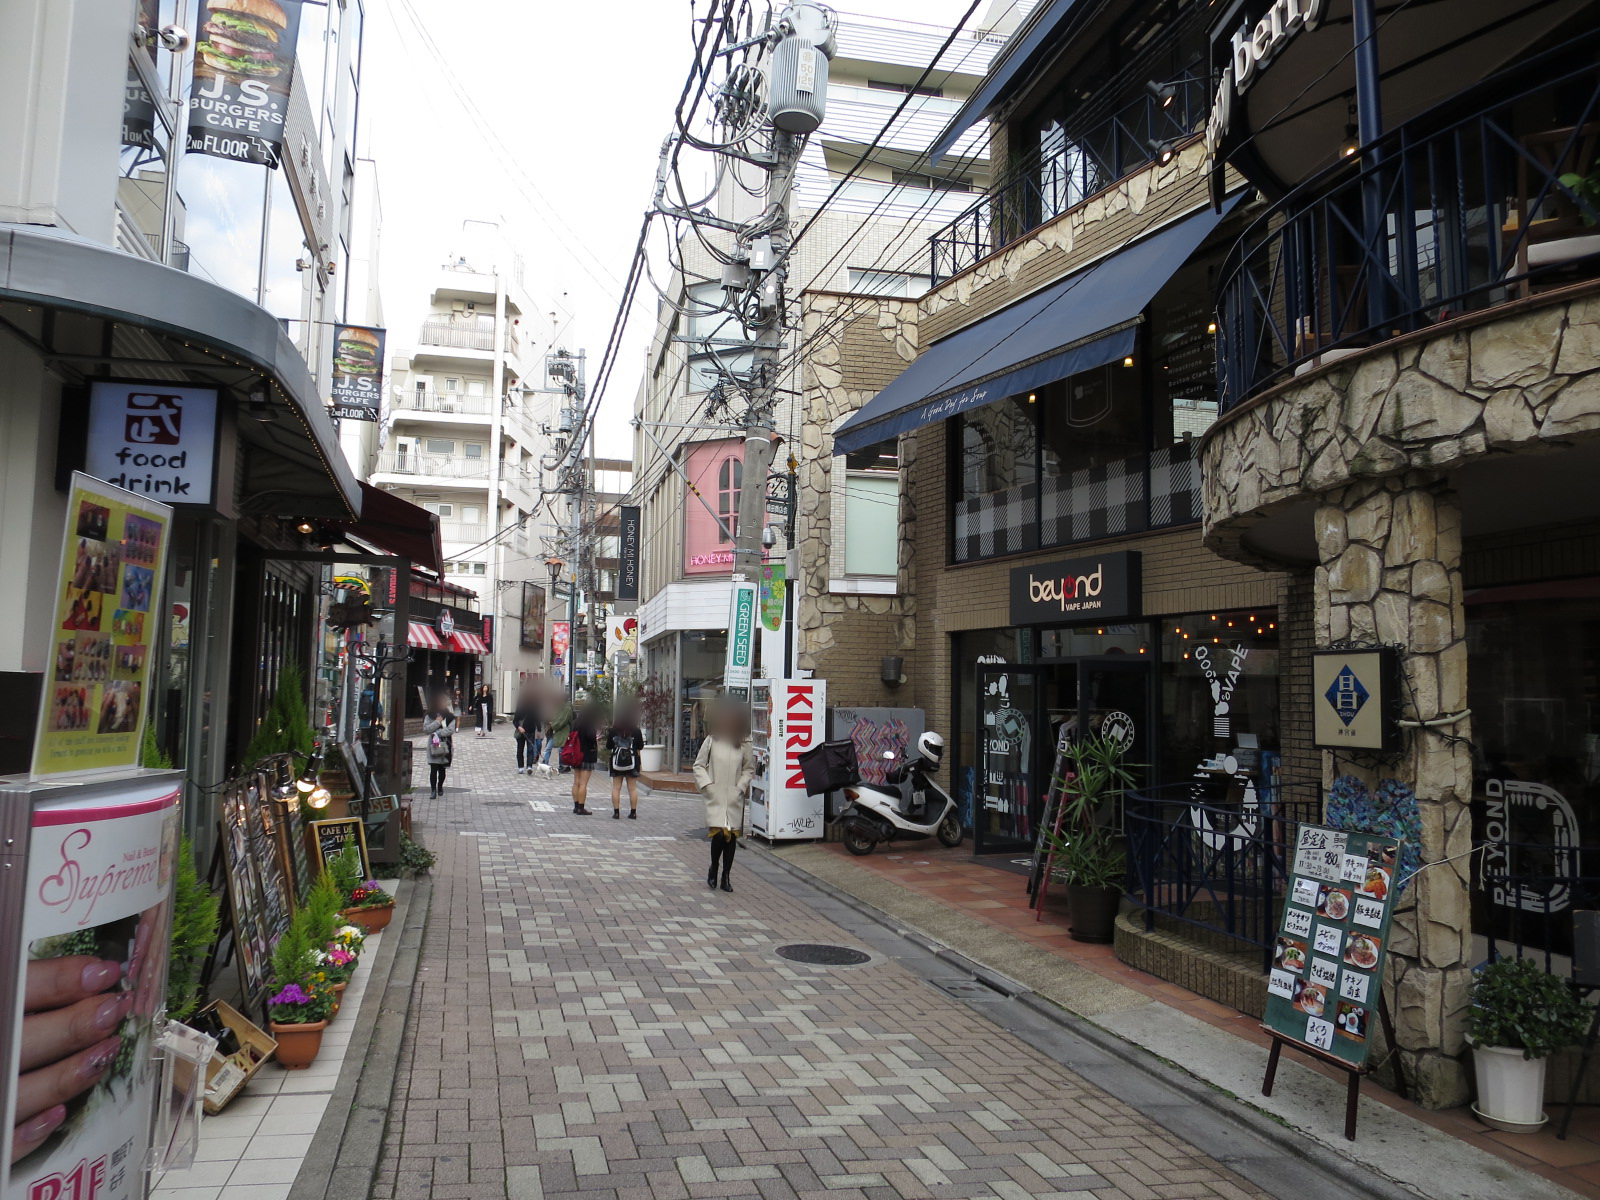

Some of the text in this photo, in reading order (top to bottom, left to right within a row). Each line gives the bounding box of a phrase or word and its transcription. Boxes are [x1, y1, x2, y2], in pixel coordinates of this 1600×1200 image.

[190, 98, 284, 125] BURGERS
[206, 113, 261, 132] CAFE
[186, 134, 249, 159] 2ND FLOOR
[333, 389, 380, 399] BURGERS
[341, 396, 369, 405] CAFE
[341, 408, 364, 419] FLOOR
[921, 408, 928, 419] A
[115, 447, 186, 468] food
[107, 473, 191, 495] drink
[626, 519, 635, 547] HONEY
[627, 548, 634, 558] MI
[691, 553, 721, 566] HONEY
[625, 559, 634, 588] HONEY
[1029, 564, 1102, 612] beyond
[1066, 601, 1102, 612] VAPE JAPAN
[738, 602, 750, 637] GREEN
[736, 638, 747, 665] SEED
[1222, 644, 1248, 691] VAPE
[785, 685, 813, 789] KIRIN
[350, 798, 391, 815] CSE
[321, 826, 341, 836] CAFE
[335, 833, 355, 843] TAE
